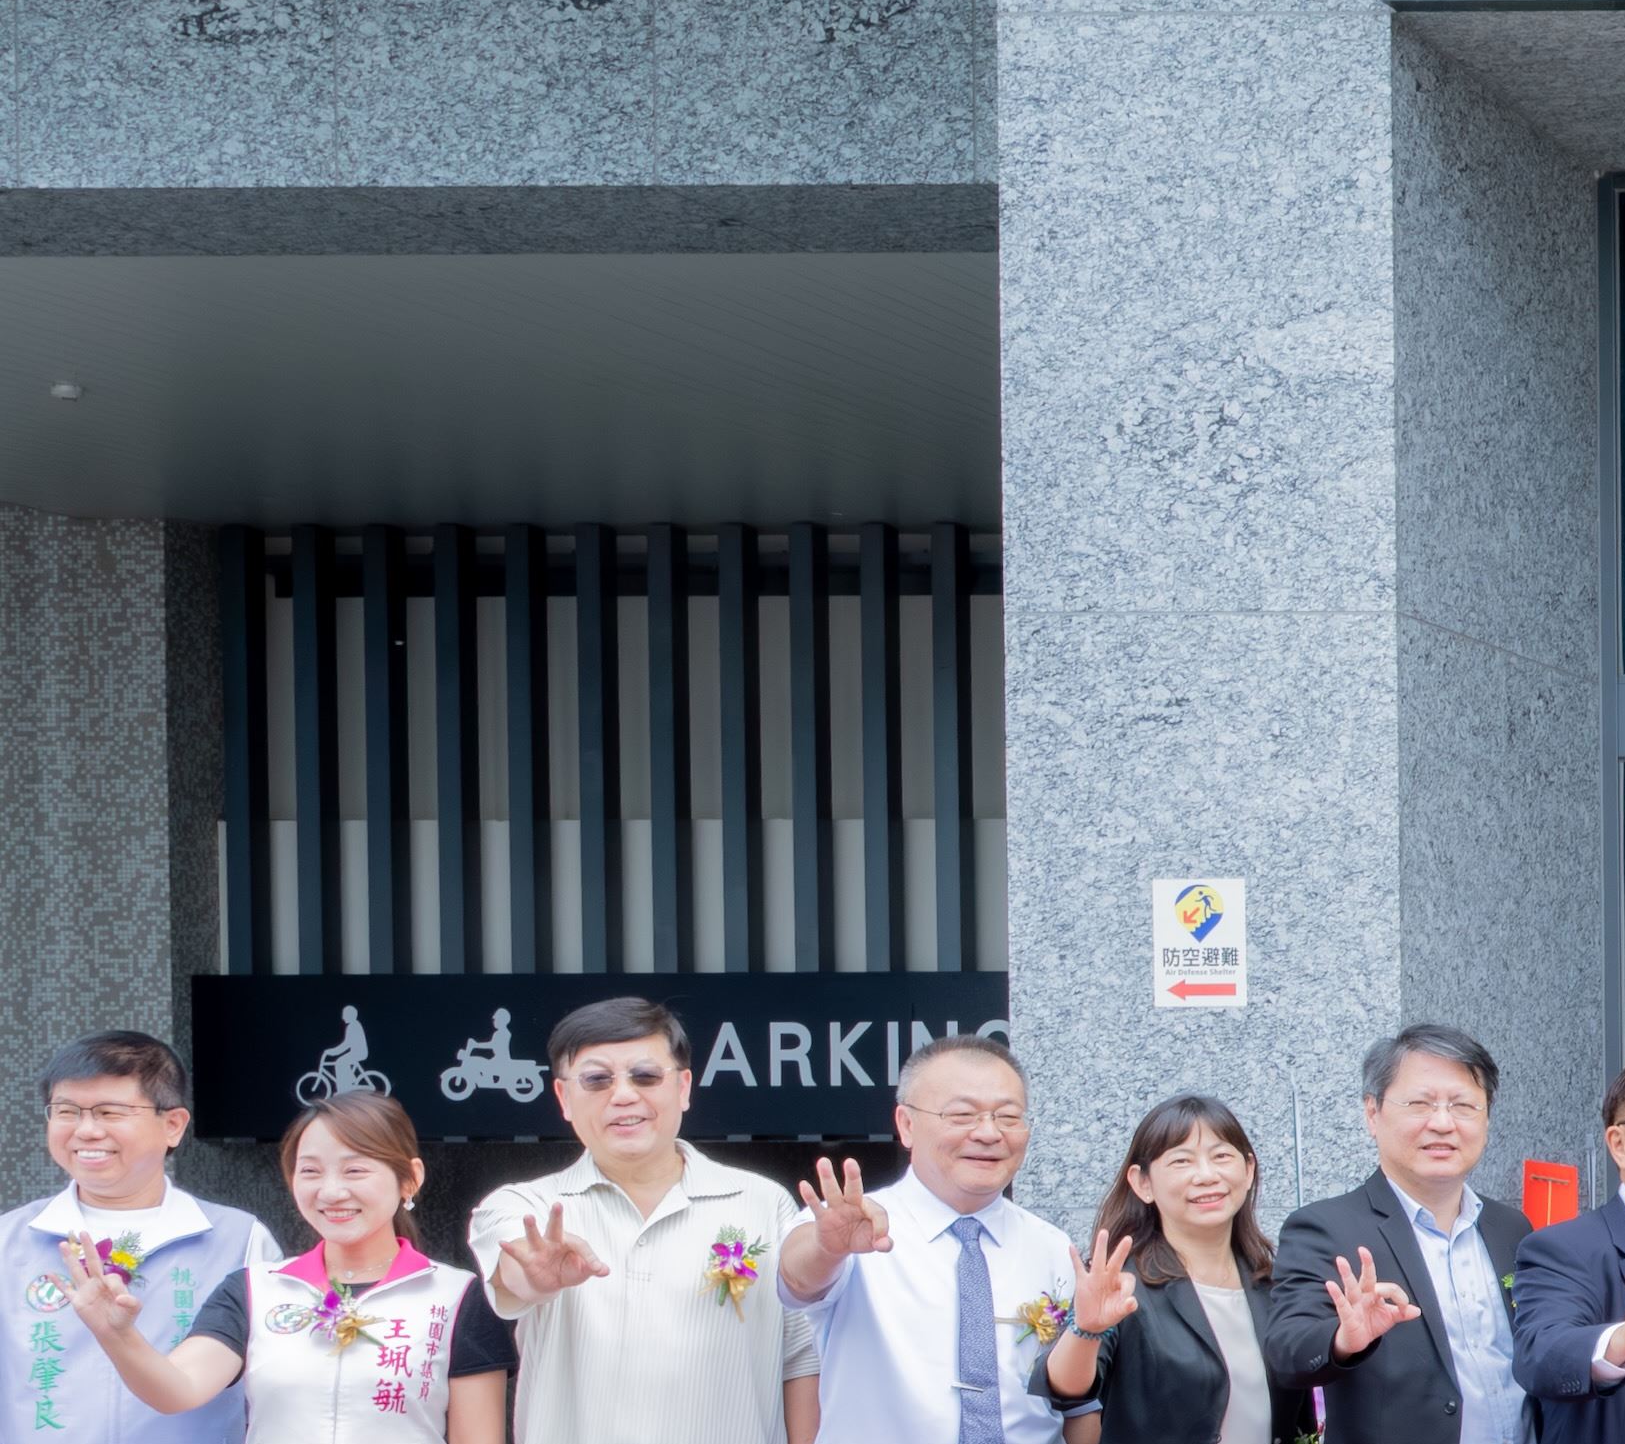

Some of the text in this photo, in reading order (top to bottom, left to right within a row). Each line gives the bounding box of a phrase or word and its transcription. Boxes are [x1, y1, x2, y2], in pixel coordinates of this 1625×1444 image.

[1163, 947, 1239, 967] 防空避難
[1165, 968, 1237, 976] Air Defense Shelter
[171, 1267, 195, 1347] 桃園市
[28, 1320, 66, 1430] 張肇良
[372, 1318, 413, 1414] 王珮毓
[418, 1304, 449, 1402] 桃園市議員
